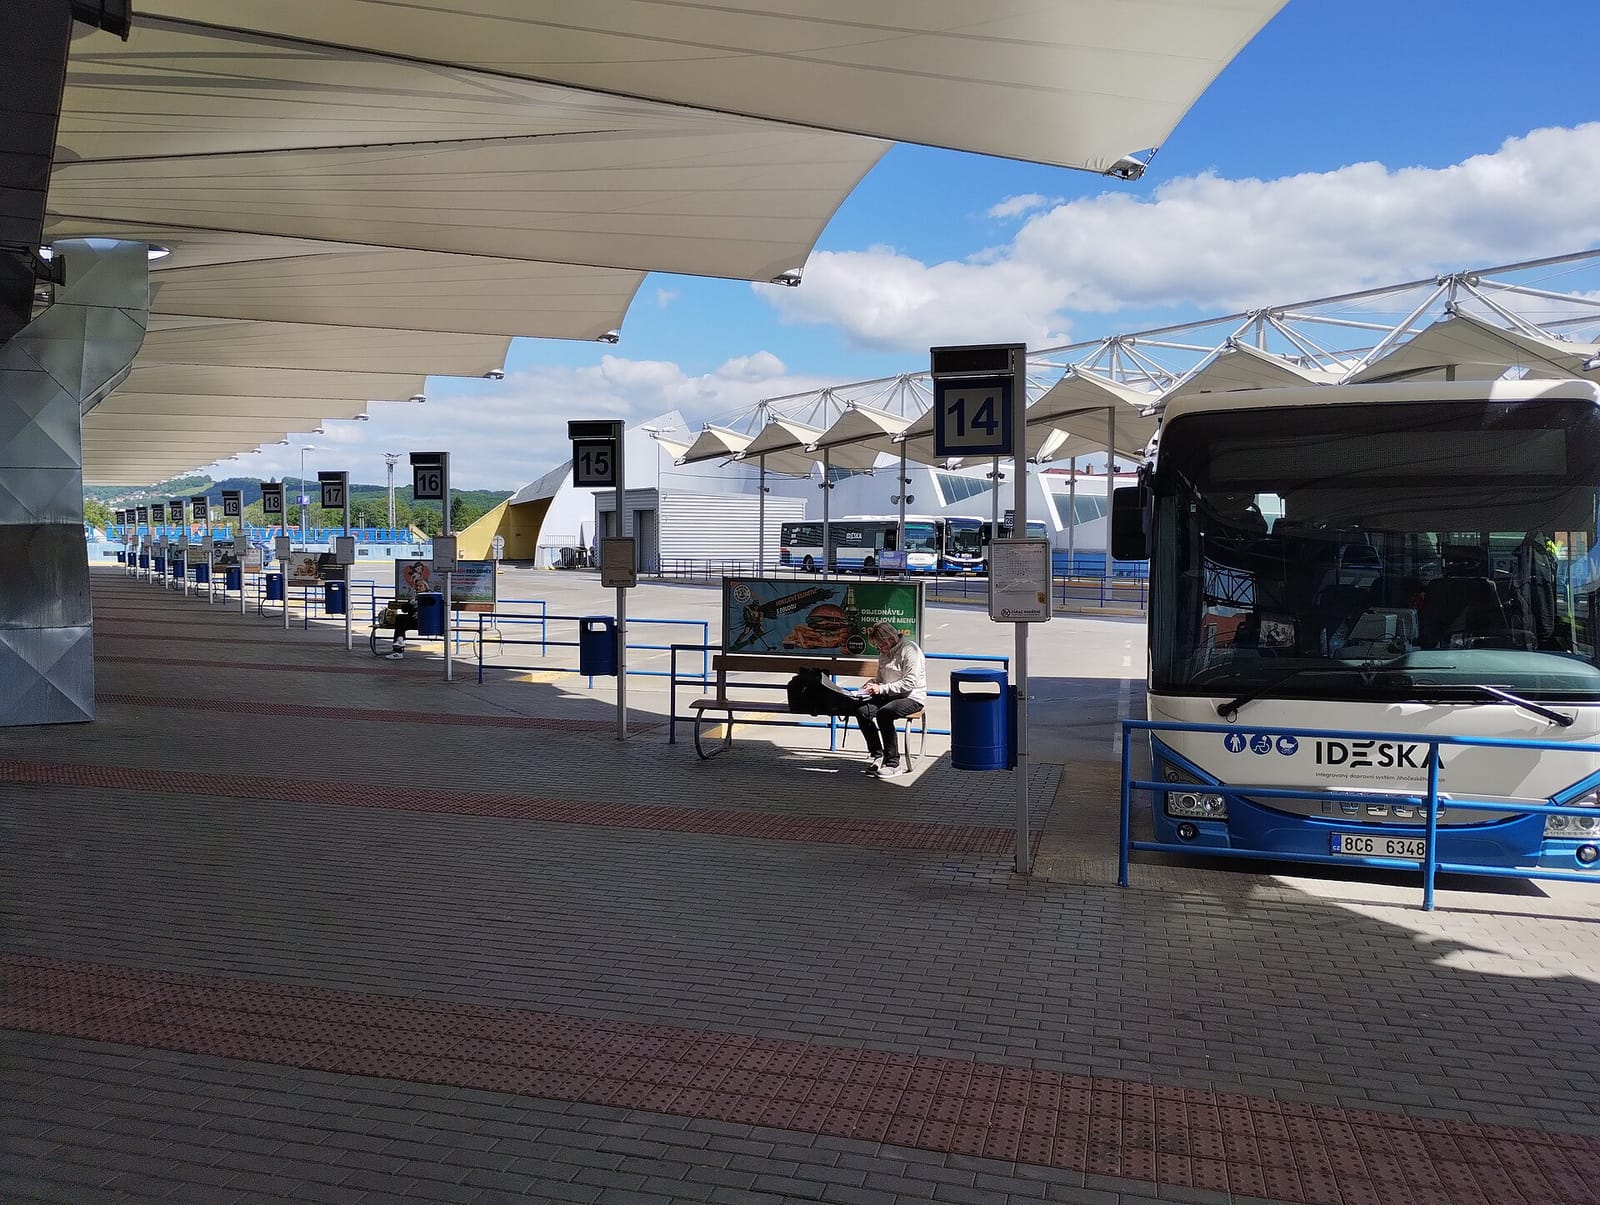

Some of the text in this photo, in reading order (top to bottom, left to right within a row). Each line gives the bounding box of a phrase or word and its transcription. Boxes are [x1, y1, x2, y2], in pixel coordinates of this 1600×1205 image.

[947, 396, 999, 437] 14
[580, 451, 609, 476] 15
[418, 473, 440, 492] 16
[325, 488, 341, 502] 17
[226, 501, 238, 513] 19
[265, 496, 280, 508] 18
[154, 511, 163, 519] 22
[173, 509, 182, 518] 21
[195, 505, 206, 516] 20
[861, 607, 904, 616] OBJEDNÁVEJ
[1316, 741, 1445, 769] IDESKA
[1315, 772, 1348, 780] Integrovaný
[1349, 772, 1375, 780] dopravní
[1344, 837, 1425, 856] 8C6 6348
